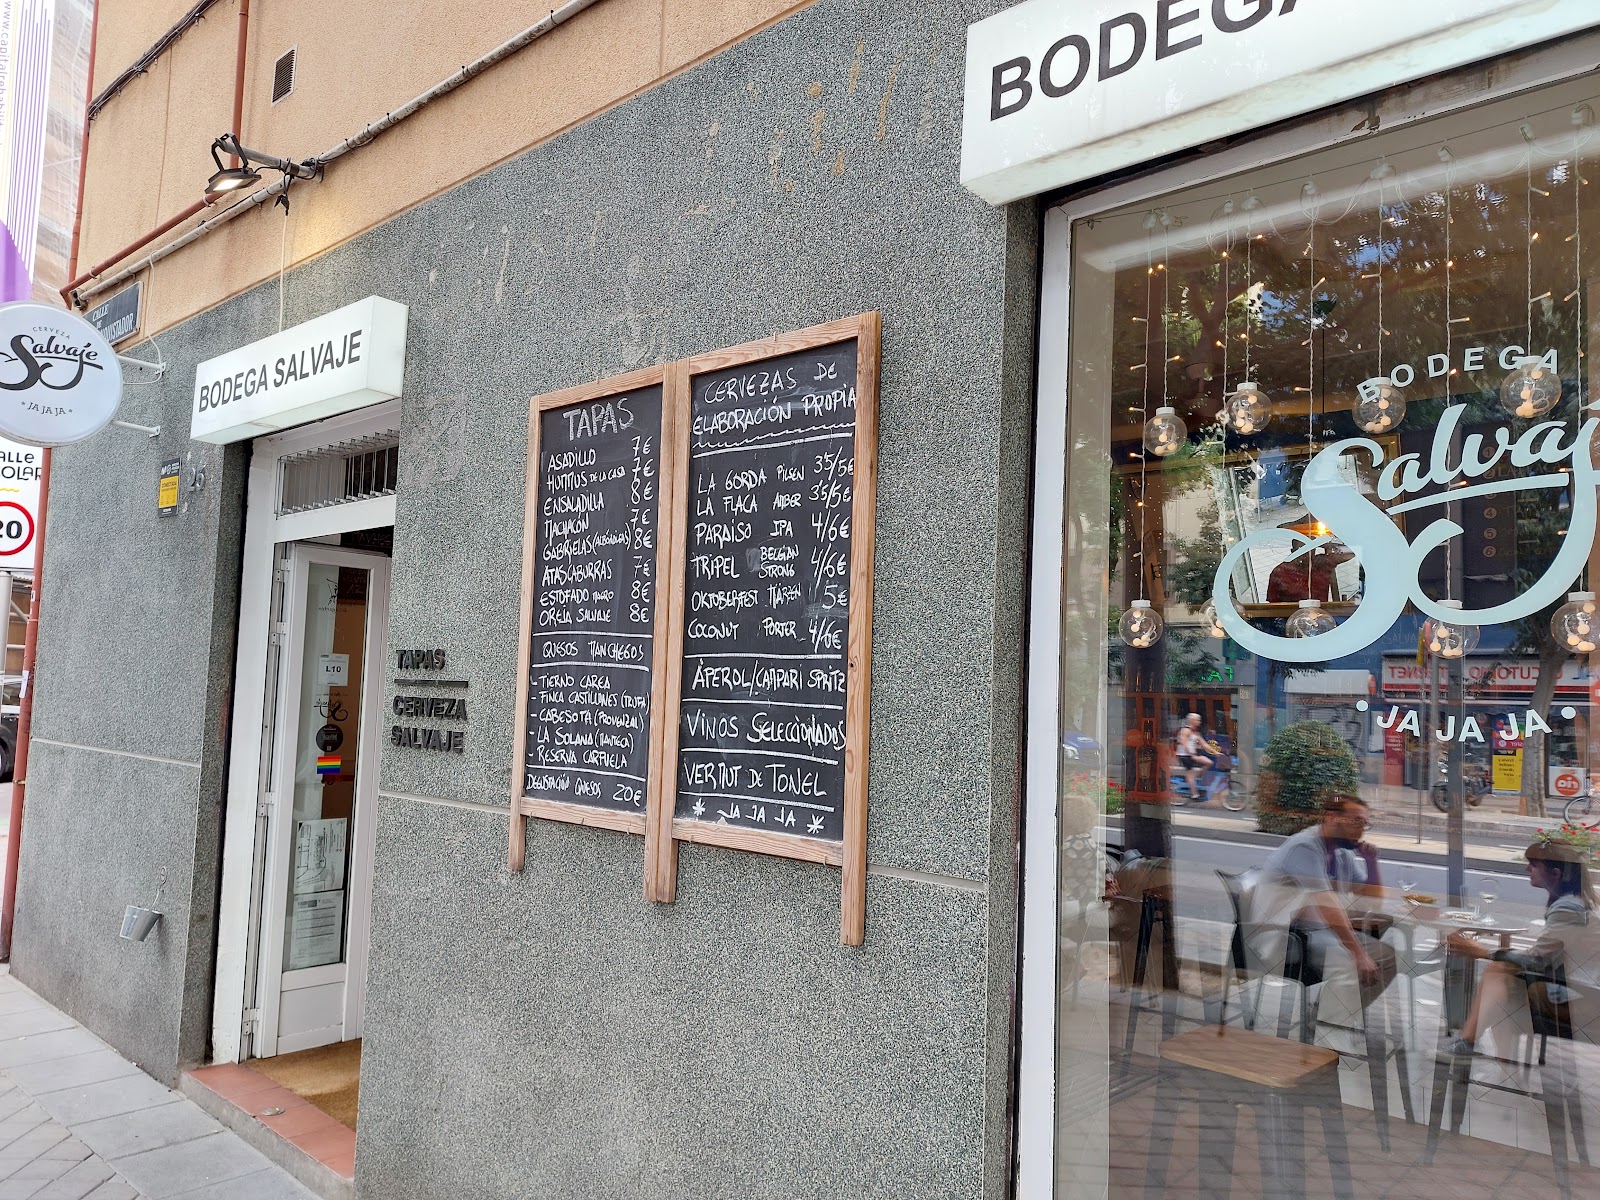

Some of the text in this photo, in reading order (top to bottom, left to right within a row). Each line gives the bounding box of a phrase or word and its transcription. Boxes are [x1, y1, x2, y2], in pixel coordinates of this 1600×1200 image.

[92, 303, 109, 322] CALLE
[32, 326, 71, 340] CERVEZA
[0, 334, 104, 391] Salvaje
[198, 329, 363, 413] BODEGA SALVAJE
[1355, 345, 1559, 404] BODEGA
[704, 361, 838, 404] CERVEZAS DE
[26, 401, 66, 417] JA JA JA
[562, 397, 635, 441] TAPAS
[692, 383, 857, 436] ELABORACIÓN PROPIA
[547, 435, 653, 473] ASADILLO 7€
[697, 472, 716, 496] LA
[725, 467, 768, 492] GORDA
[543, 479, 654, 516] ENSALADILLA 8€
[696, 496, 715, 517] LA
[723, 493, 758, 517] FLACA
[772, 491, 803, 511] AMBER
[630, 508, 651, 531] 7€
[769, 519, 794, 538] IPA
[810, 509, 850, 543] 4/6€
[543, 534, 593, 565] GABRIELAS
[634, 527, 653, 550] 8€
[541, 558, 613, 587] ATASCABURRAS
[690, 542, 847, 589] TRIPEL BELGIAN 4/6€
[758, 561, 796, 579] STRONG
[539, 588, 590, 607] ESTOFADO
[630, 579, 652, 603] 8€
[690, 588, 759, 614] OKTOBERFEST
[822, 584, 848, 610] 5€
[539, 602, 650, 627] OREJA SALVAJE 8€
[687, 617, 740, 641] COCONUT
[761, 616, 798, 640] PORTER
[396, 648, 446, 671] TAPAS
[542, 640, 645, 662] QUESOS MANCHEGOS
[325, 665, 342, 673] L10
[538, 673, 575, 689] TIERNO
[807, 665, 847, 693] SPRITZ
[392, 695, 468, 721] CERVEZA
[538, 688, 565, 704] FINCA
[539, 708, 592, 726] CABESOTA
[686, 709, 847, 751] VINOS SELECCIONADOS
[1376, 705, 1553, 743] JA JA JA
[390, 725, 465, 754] SALVAJE
[537, 725, 550, 743] LA
[554, 726, 594, 747] SOLANA
[536, 745, 578, 767] RESERVA
[574, 777, 602, 799] QUESOS
[613, 783, 643, 807] 20€
[684, 762, 828, 797] VERMUT DE TONEL
[717, 802, 797, 828] JA JA JA
